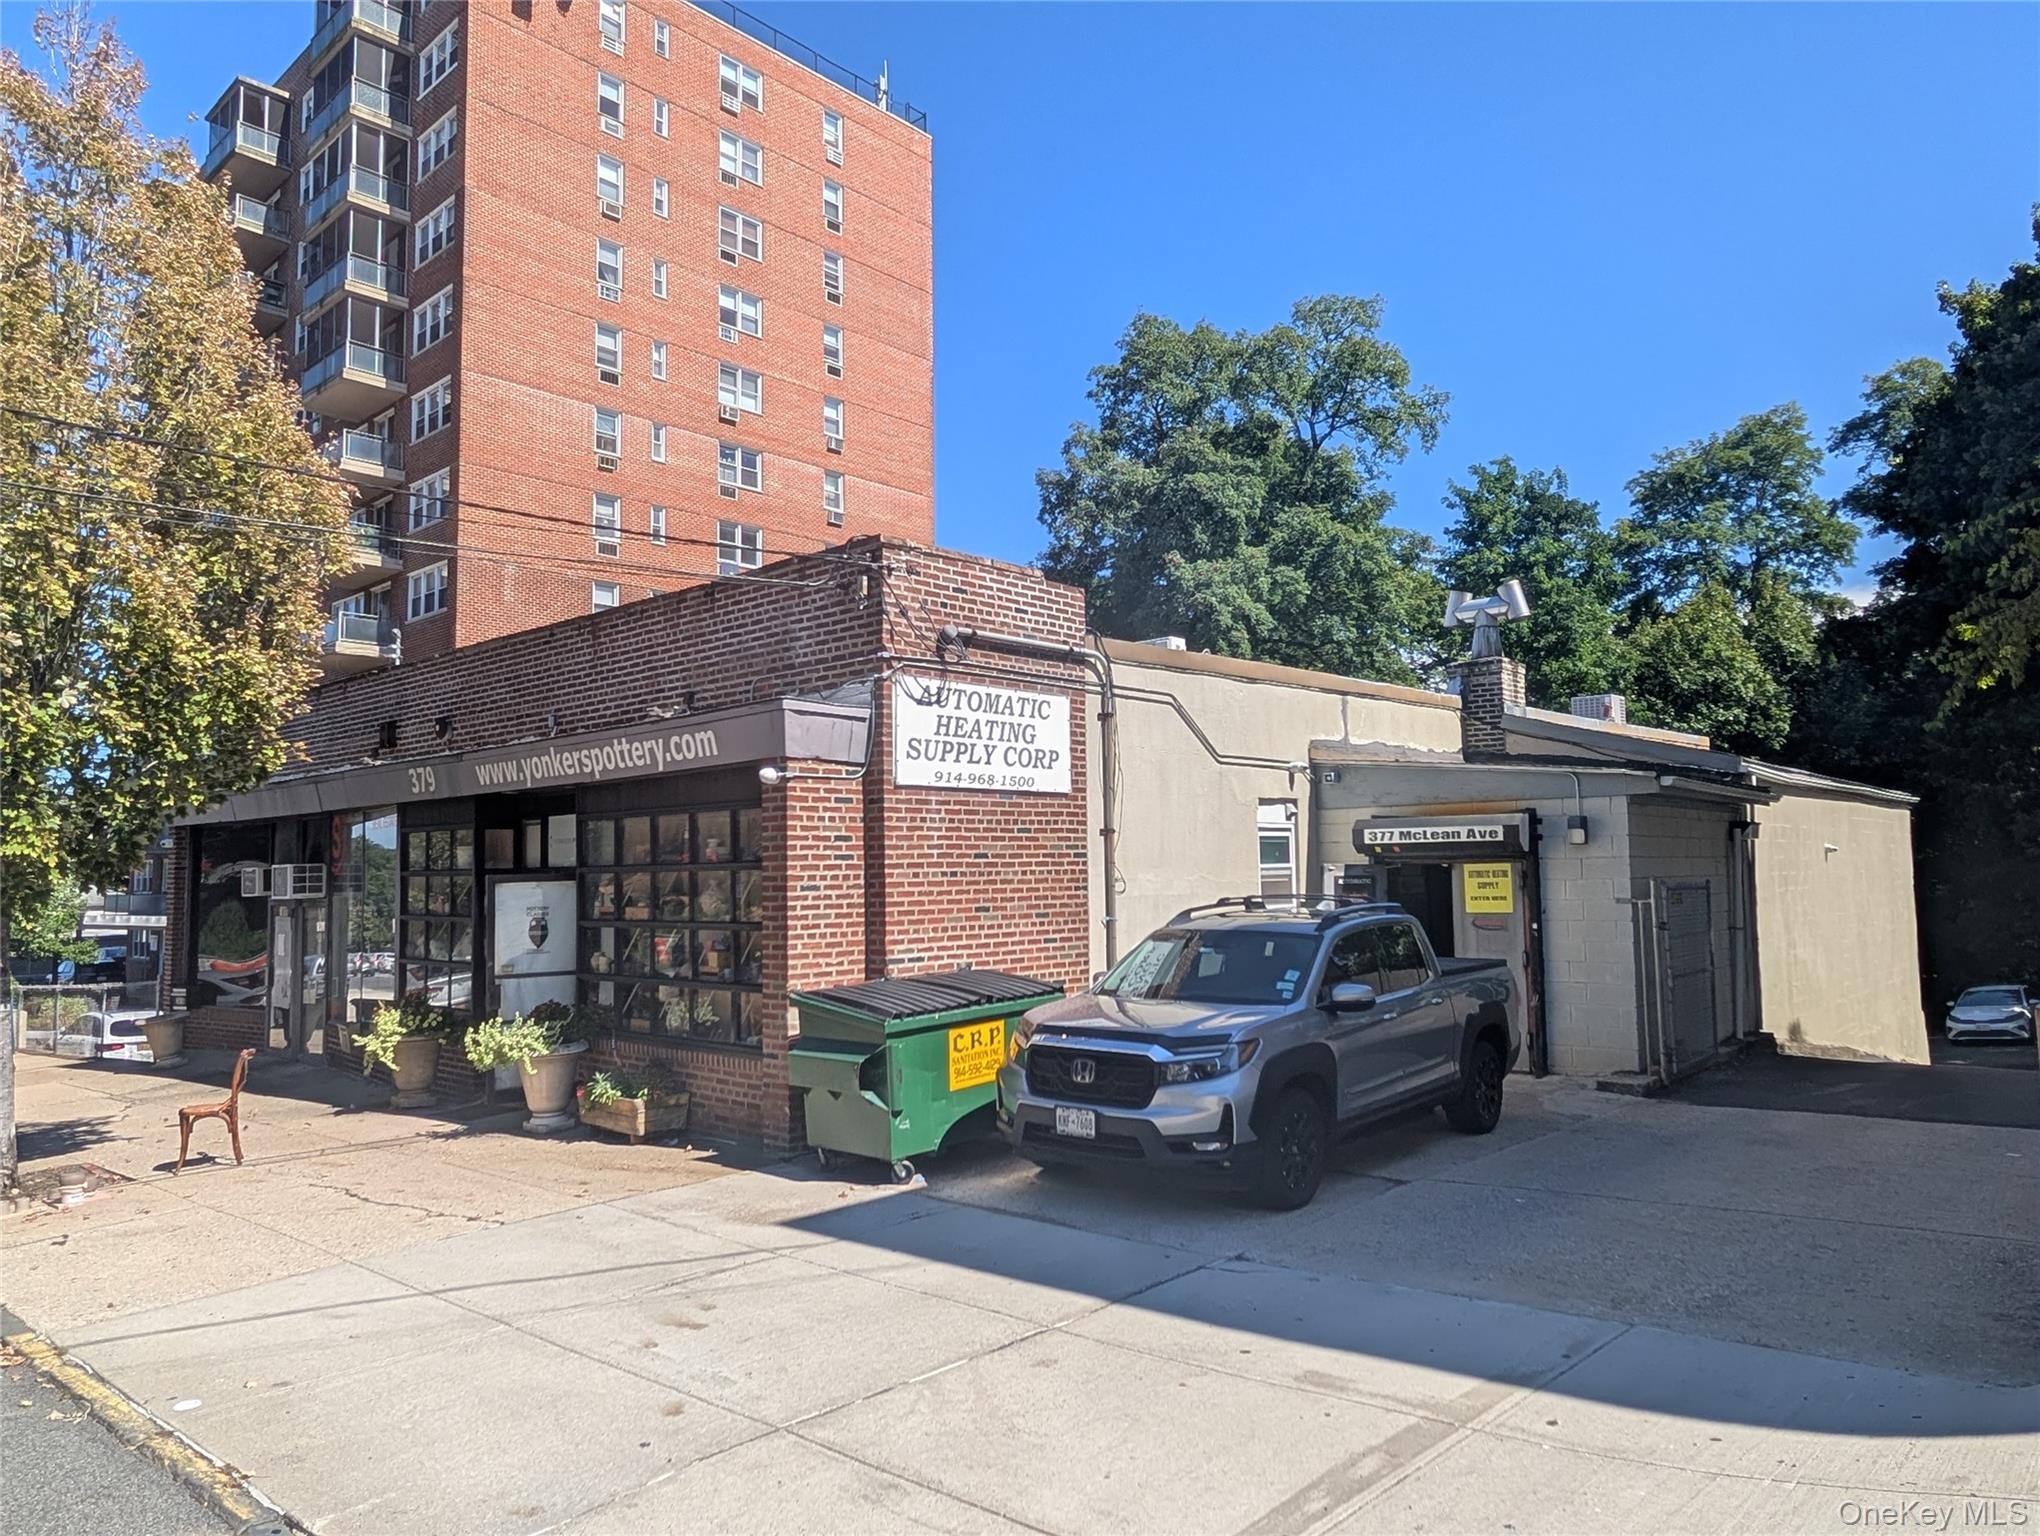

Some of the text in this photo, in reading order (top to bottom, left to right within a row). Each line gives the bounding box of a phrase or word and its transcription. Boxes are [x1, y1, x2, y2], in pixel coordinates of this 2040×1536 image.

[918, 684, 1051, 720] AUTOMATIC
[934, 714, 1037, 744] HEATING
[408, 727, 719, 794] 379 www.yonkerspottery.com
[906, 737, 1060, 770] SUPPLY CORP
[934, 771, 1035, 788] 914-968-1500
[1367, 827, 1499, 842] 377 McLean Ave
[1477, 881, 1499, 890] SUPPLY
[952, 1025, 1001, 1053] C.R.P.
[952, 1050, 988, 1067] SANITATION
